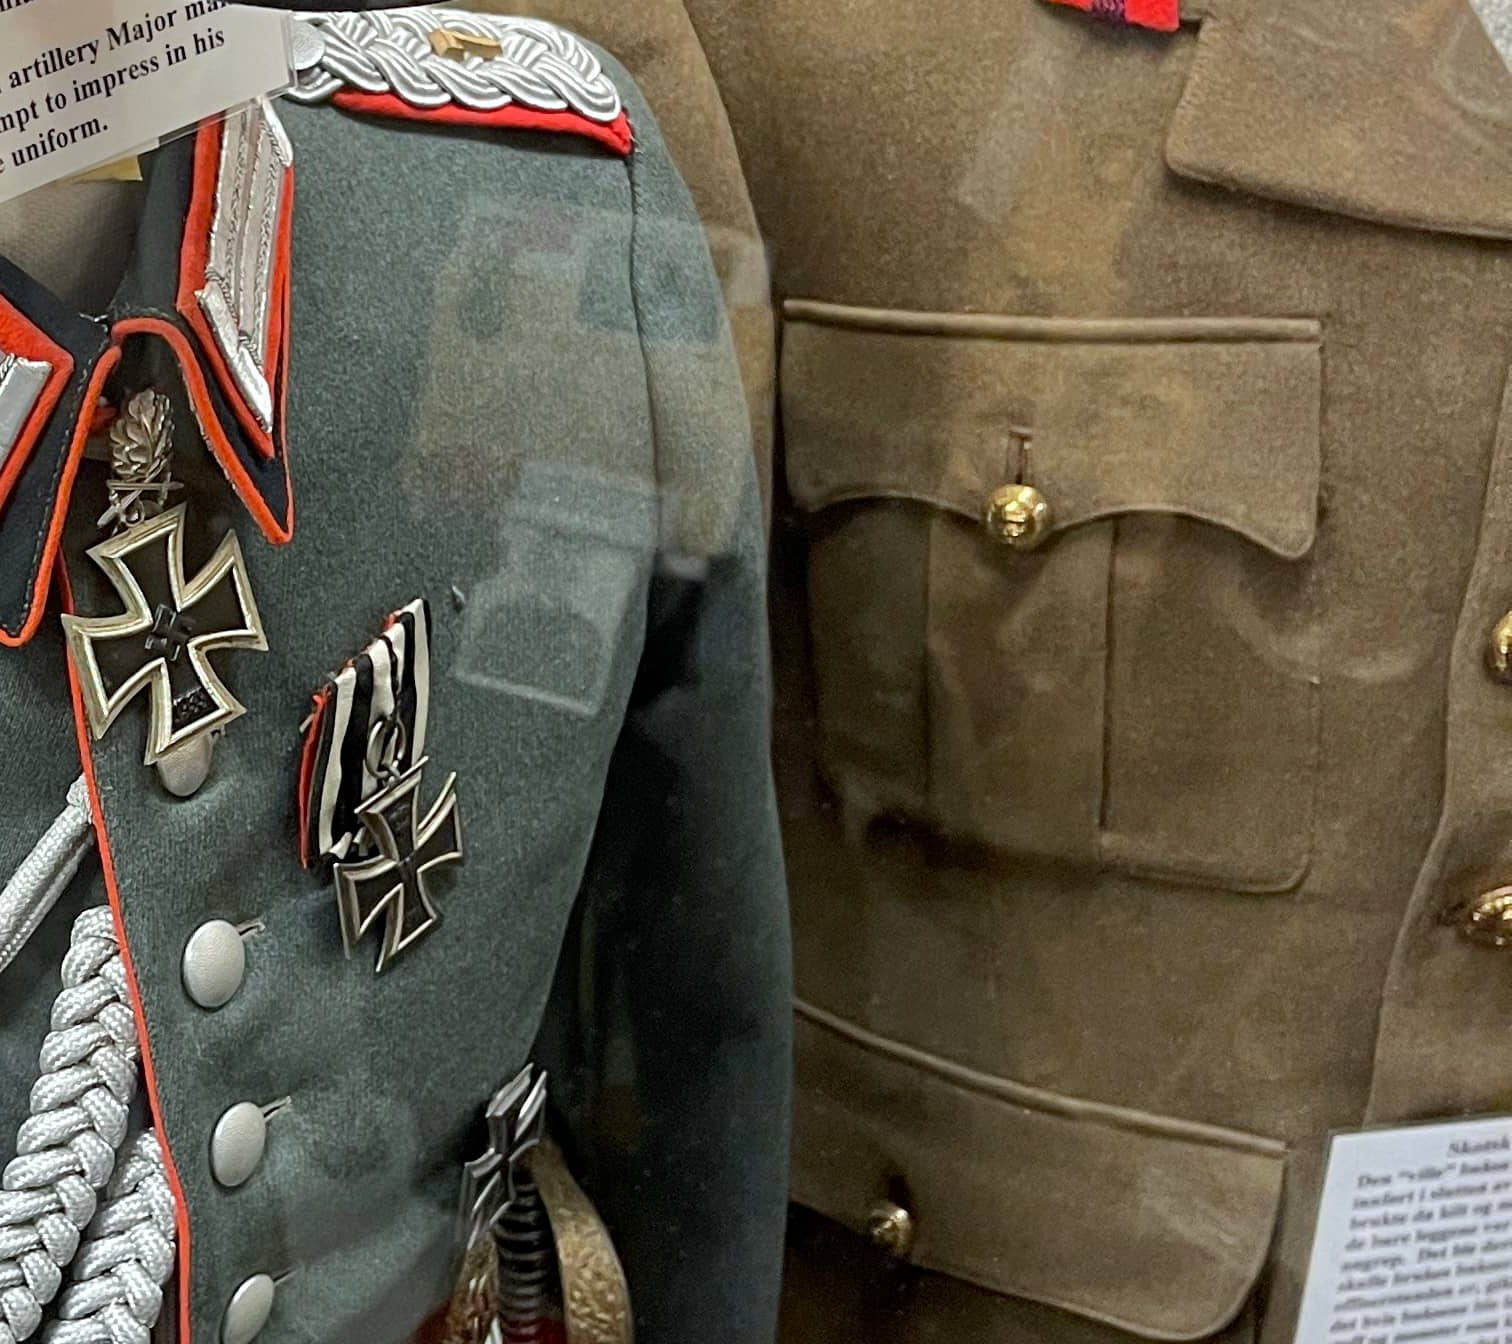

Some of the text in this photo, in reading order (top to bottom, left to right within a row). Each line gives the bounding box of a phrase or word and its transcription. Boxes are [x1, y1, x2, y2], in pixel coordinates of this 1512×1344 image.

[9, 39, 100, 89] artillery
[106, 9, 177, 51] Major
[45, 92, 67, 114] to
[73, 55, 160, 102] impress
[166, 44, 187, 67] in
[193, 27, 225, 55] his
[11, 118, 109, 167] uniform.
